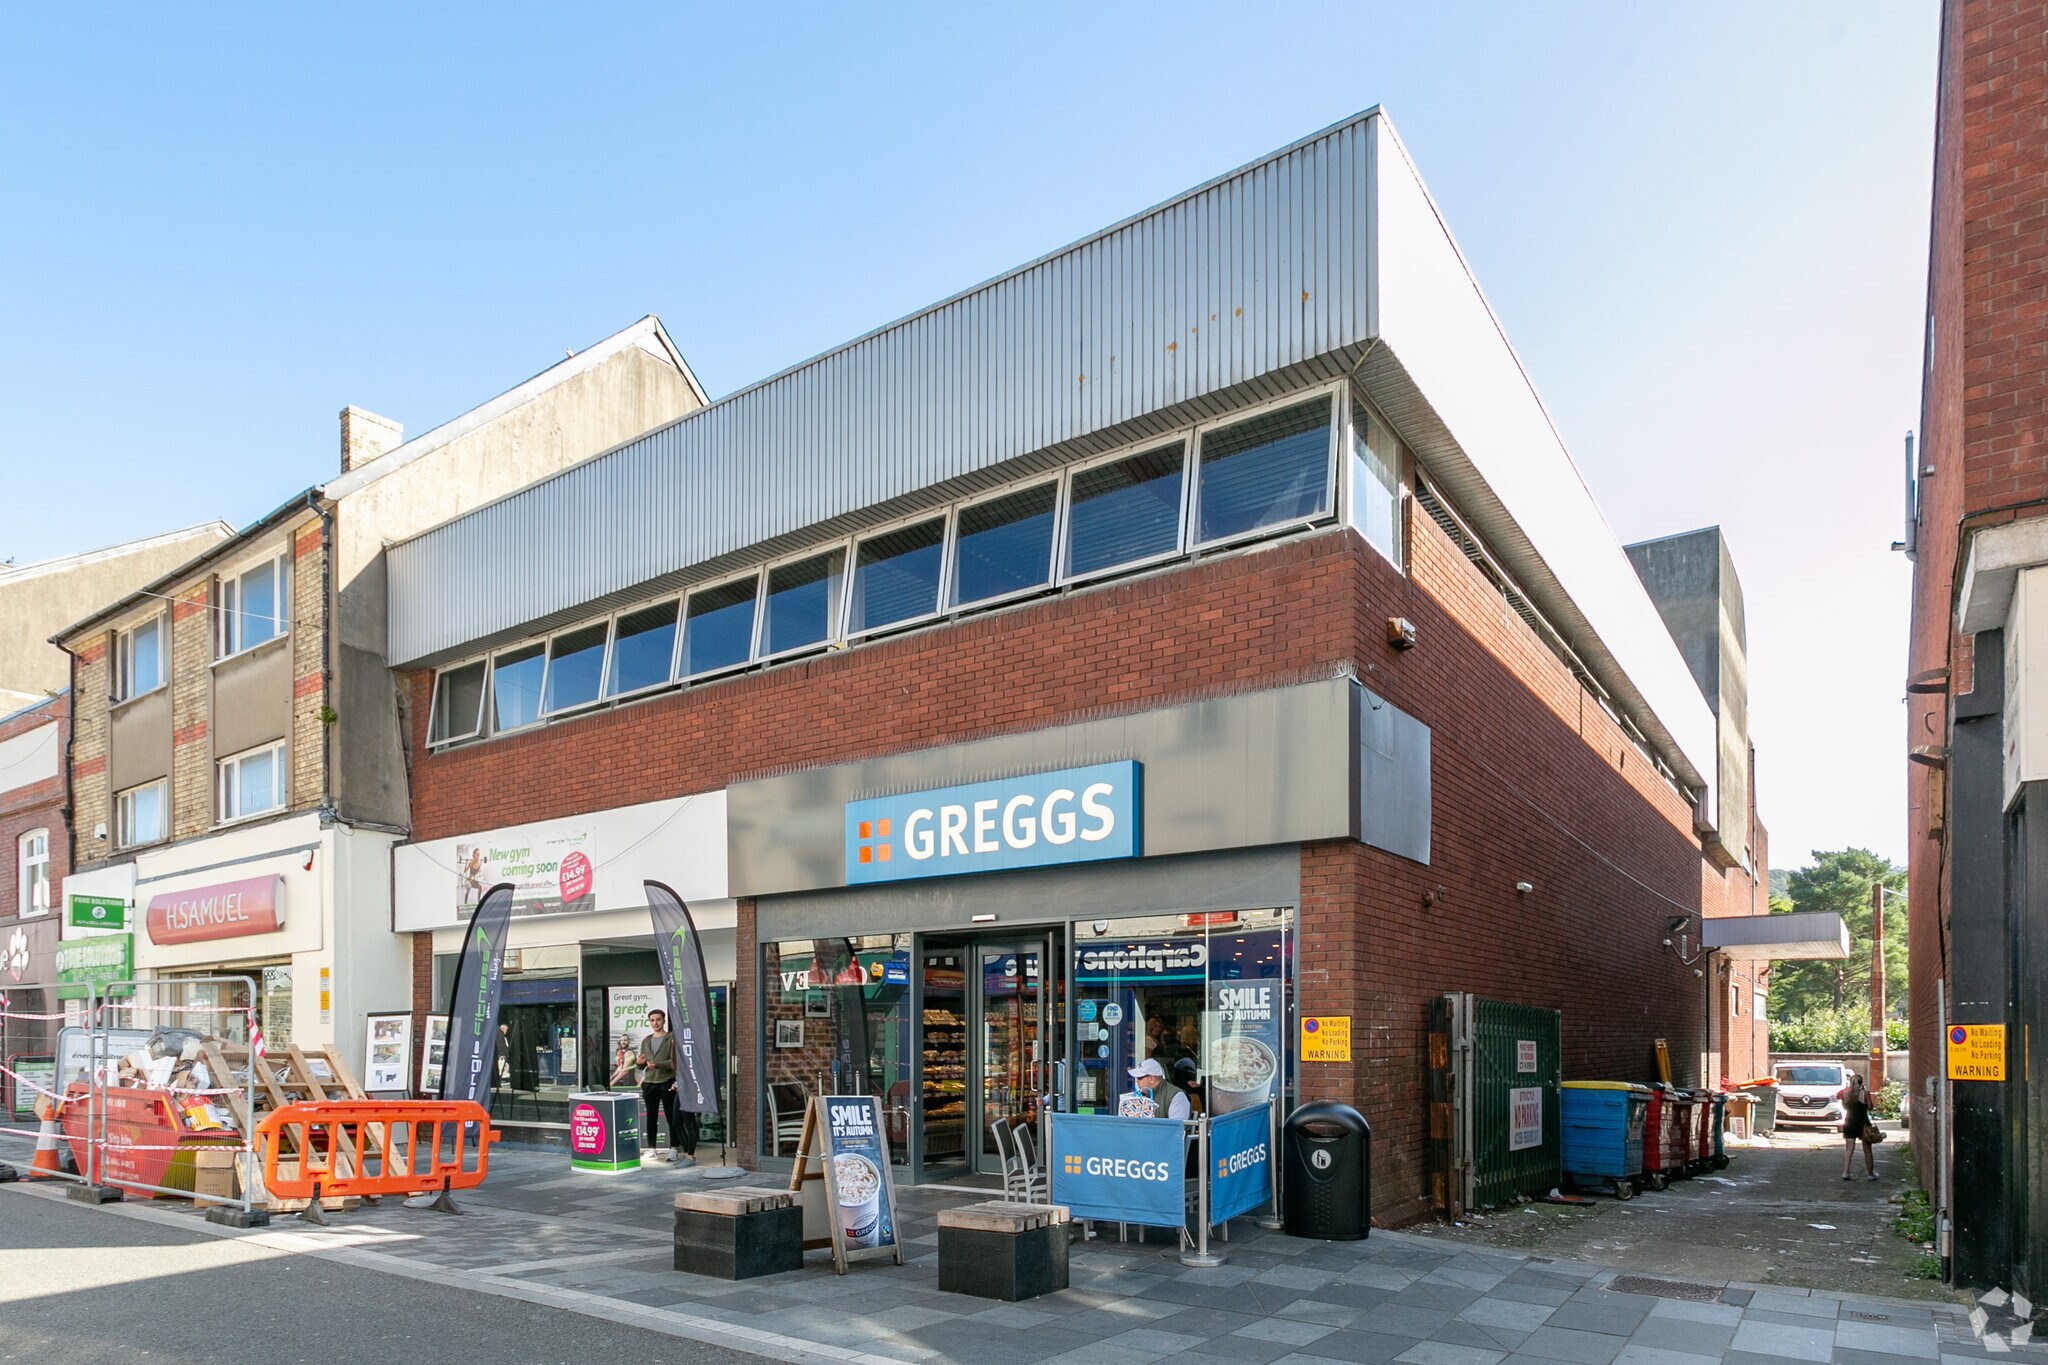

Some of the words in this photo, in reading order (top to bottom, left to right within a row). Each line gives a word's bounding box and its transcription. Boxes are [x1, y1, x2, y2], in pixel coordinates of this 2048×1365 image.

[904, 782, 1115, 861] GREGGS
[489, 848, 510, 862] New
[510, 847, 530, 863] gym
[502, 866, 535, 878] coming
[536, 861, 558, 873] soon
[91, 897, 123, 906] SOLUTIONS
[614, 993, 632, 1001] Great
[1219, 987, 1271, 1010] SMILE
[613, 1003, 648, 1019] great
[1219, 1010, 1234, 1021] IT'S
[1235, 1009, 1271, 1021] AUTUMN
[625, 1015, 649, 1031] pric
[1330, 1020, 1348, 1029] Waiting
[1329, 1030, 1348, 1039] Loading
[1971, 1028, 1978, 1037] No
[1980, 1028, 2001, 1039] Waiting
[1330, 1038, 1348, 1048] Parking
[1971, 1040, 1978, 1048] No
[1980, 1039, 2001, 1051] Loading
[1307, 1050, 1346, 1060] WARNING
[1971, 1051, 1978, 1059] No
[1980, 1050, 2001, 1062] Parking
[1955, 1065, 1999, 1077] WARNING
[831, 1104, 872, 1126] SMILE
[1522, 1103, 1539, 1128] PARKING
[833, 1126, 846, 1137] IT'S
[846, 1125, 874, 1136] AUTUMN
[1229, 1142, 1266, 1174] GREGGS
[1086, 1156, 1169, 1182] GREGGS
